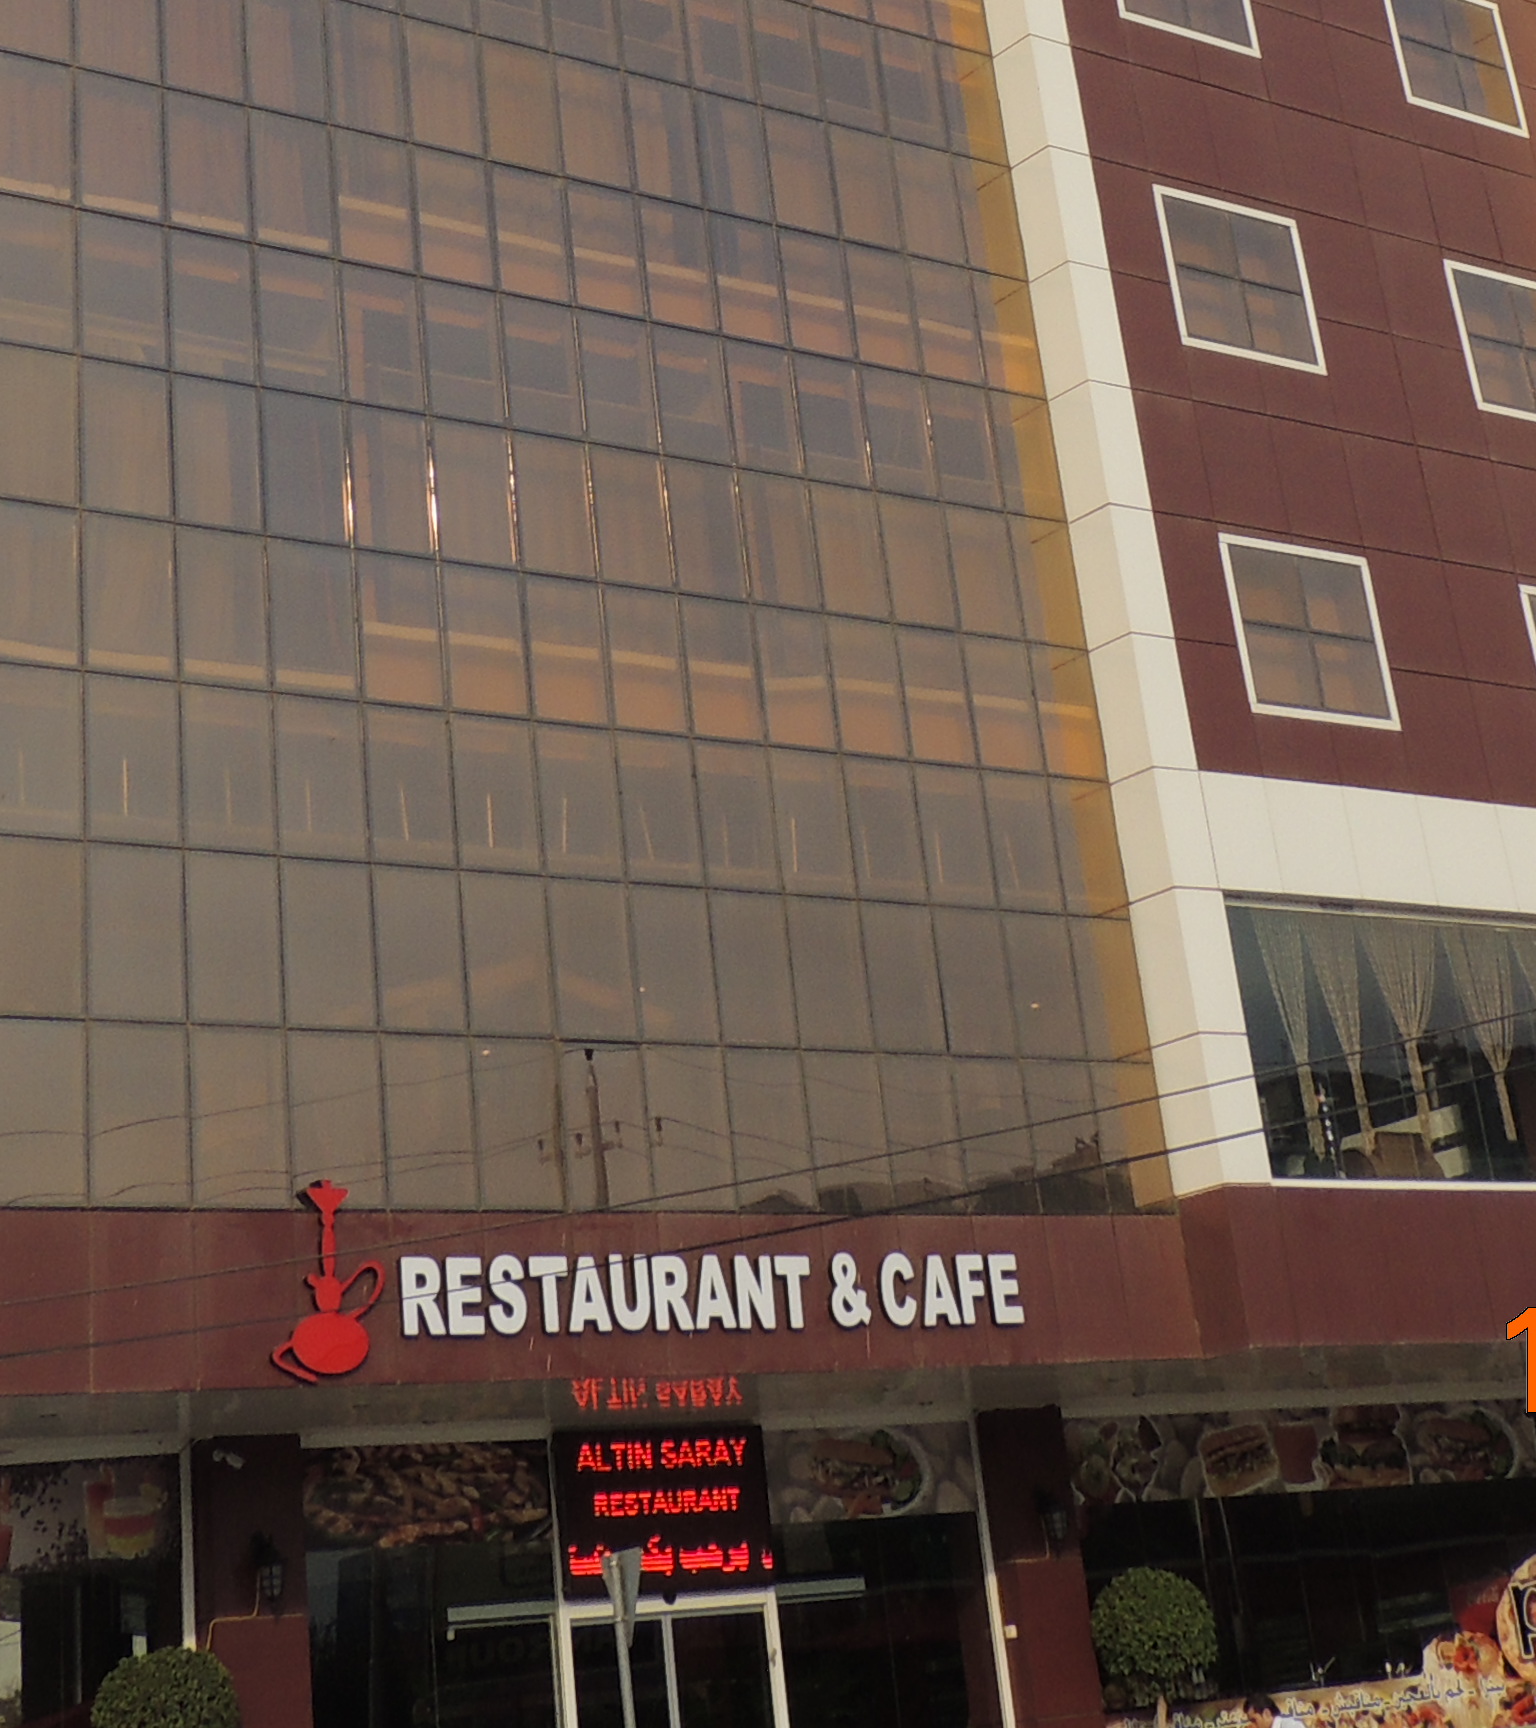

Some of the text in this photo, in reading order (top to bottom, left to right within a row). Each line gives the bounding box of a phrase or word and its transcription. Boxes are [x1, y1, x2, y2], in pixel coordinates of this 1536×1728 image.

[400, 1251, 1025, 1336] RESTAURANT & CAFE
[577, 1436, 747, 1471] ALTIN SARAY
[593, 1486, 740, 1517] RESTAURANT
